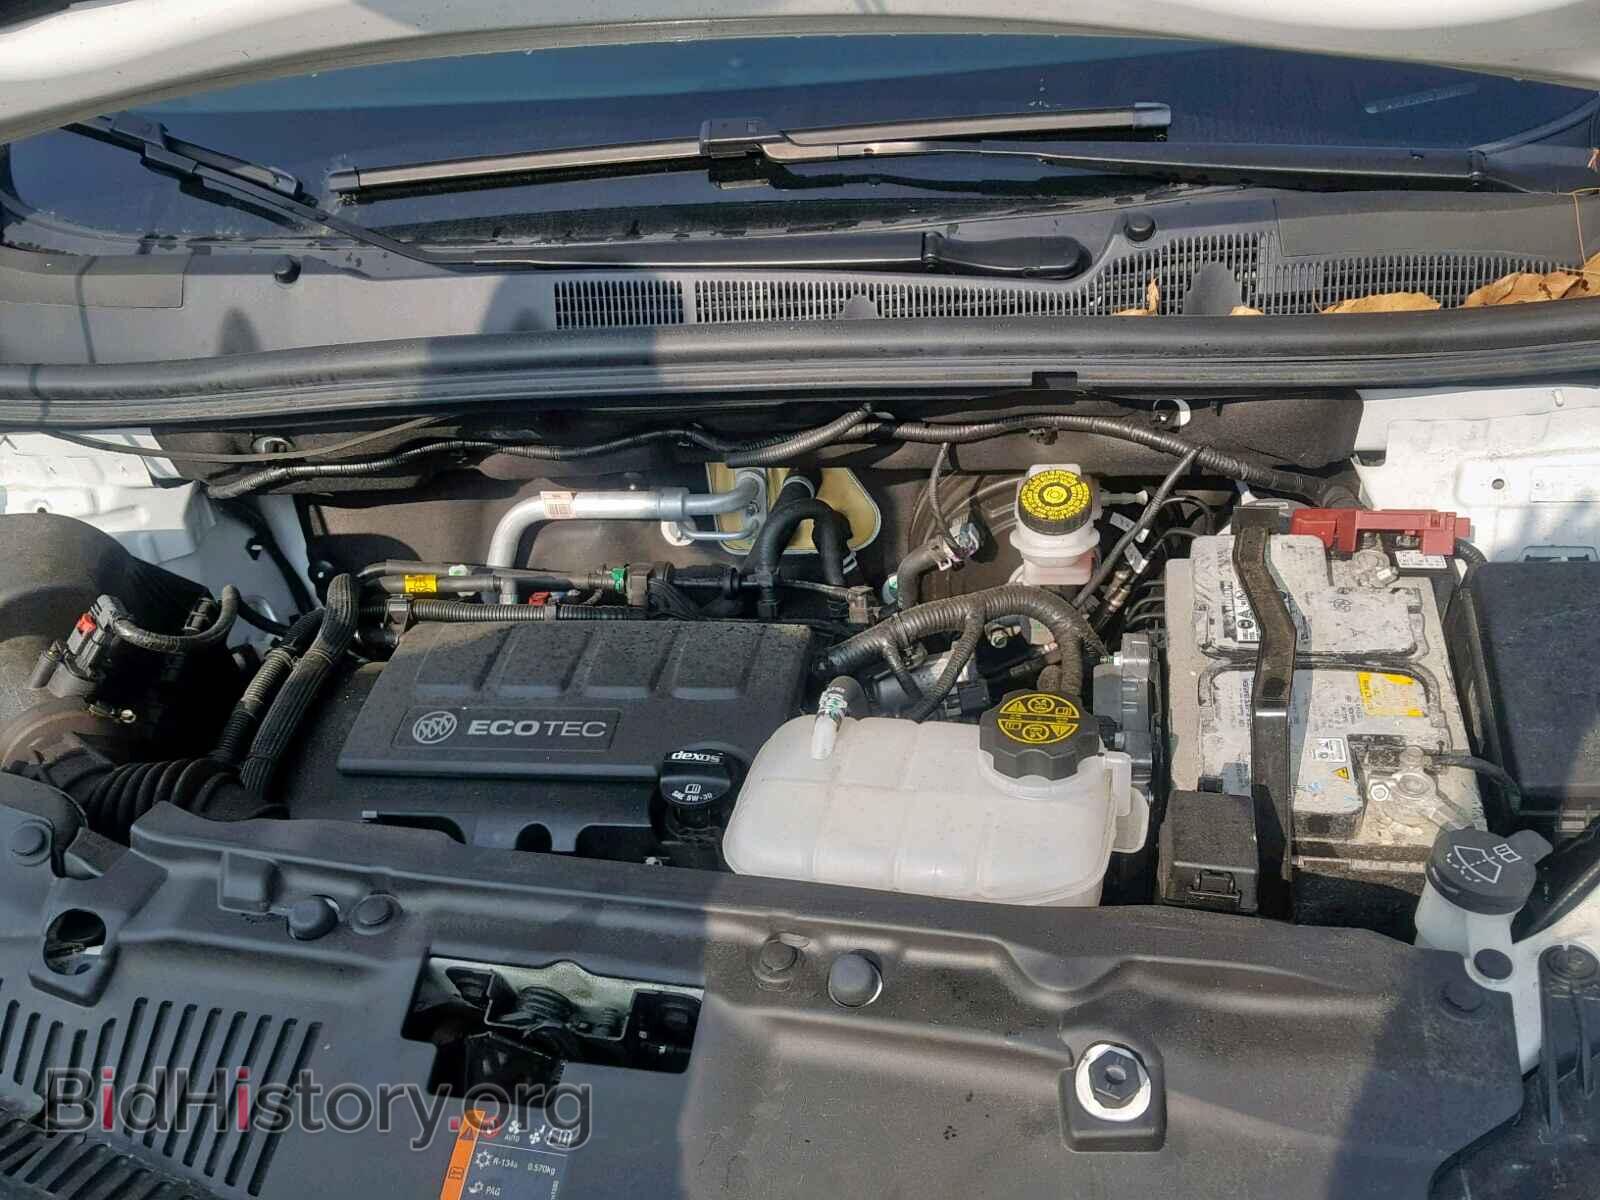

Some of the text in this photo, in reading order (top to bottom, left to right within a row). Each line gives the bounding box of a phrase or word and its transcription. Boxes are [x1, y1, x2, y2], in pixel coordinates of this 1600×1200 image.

[467, 719, 607, 737] ECOTEC
[671, 750, 720, 763] dexos
[504, 1134, 521, 1142] AUTO
[485, 1185, 501, 1196] PAG
